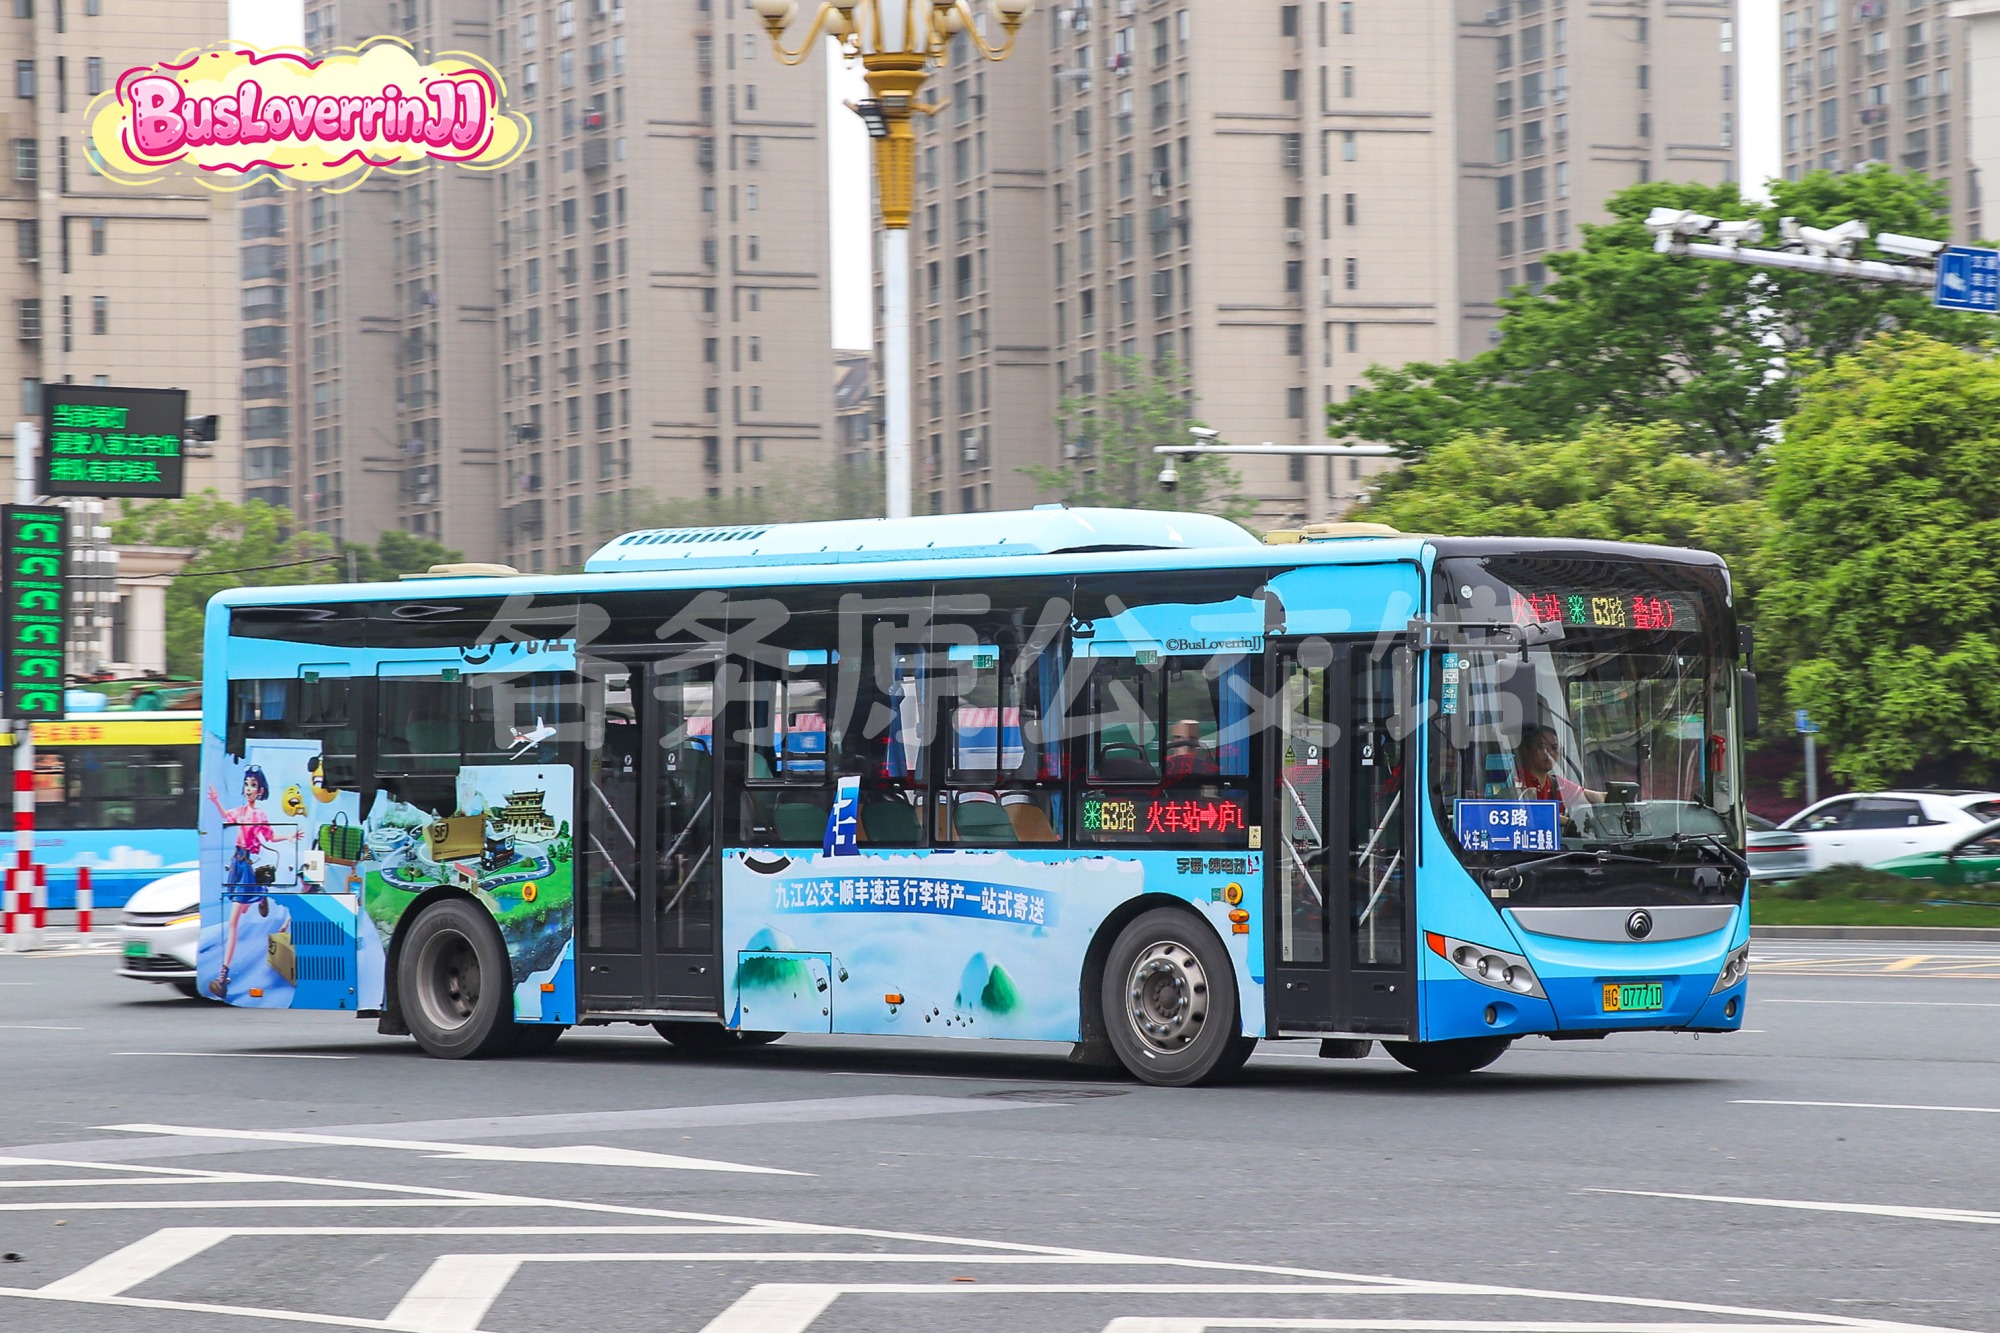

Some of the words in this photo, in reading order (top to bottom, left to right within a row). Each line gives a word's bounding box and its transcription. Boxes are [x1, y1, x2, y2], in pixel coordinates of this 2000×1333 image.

[1512, 593, 1563, 624] 火车站
[1591, 596, 1626, 628] 63路
[1101, 801, 1136, 832] 63路
[1146, 801, 1200, 833] 火车站
[1489, 808, 1529, 826] 63路
[1512, 829, 1554, 851] 庐山三叠泉
[903, 878, 1045, 925] 行李特产一站式寄送
